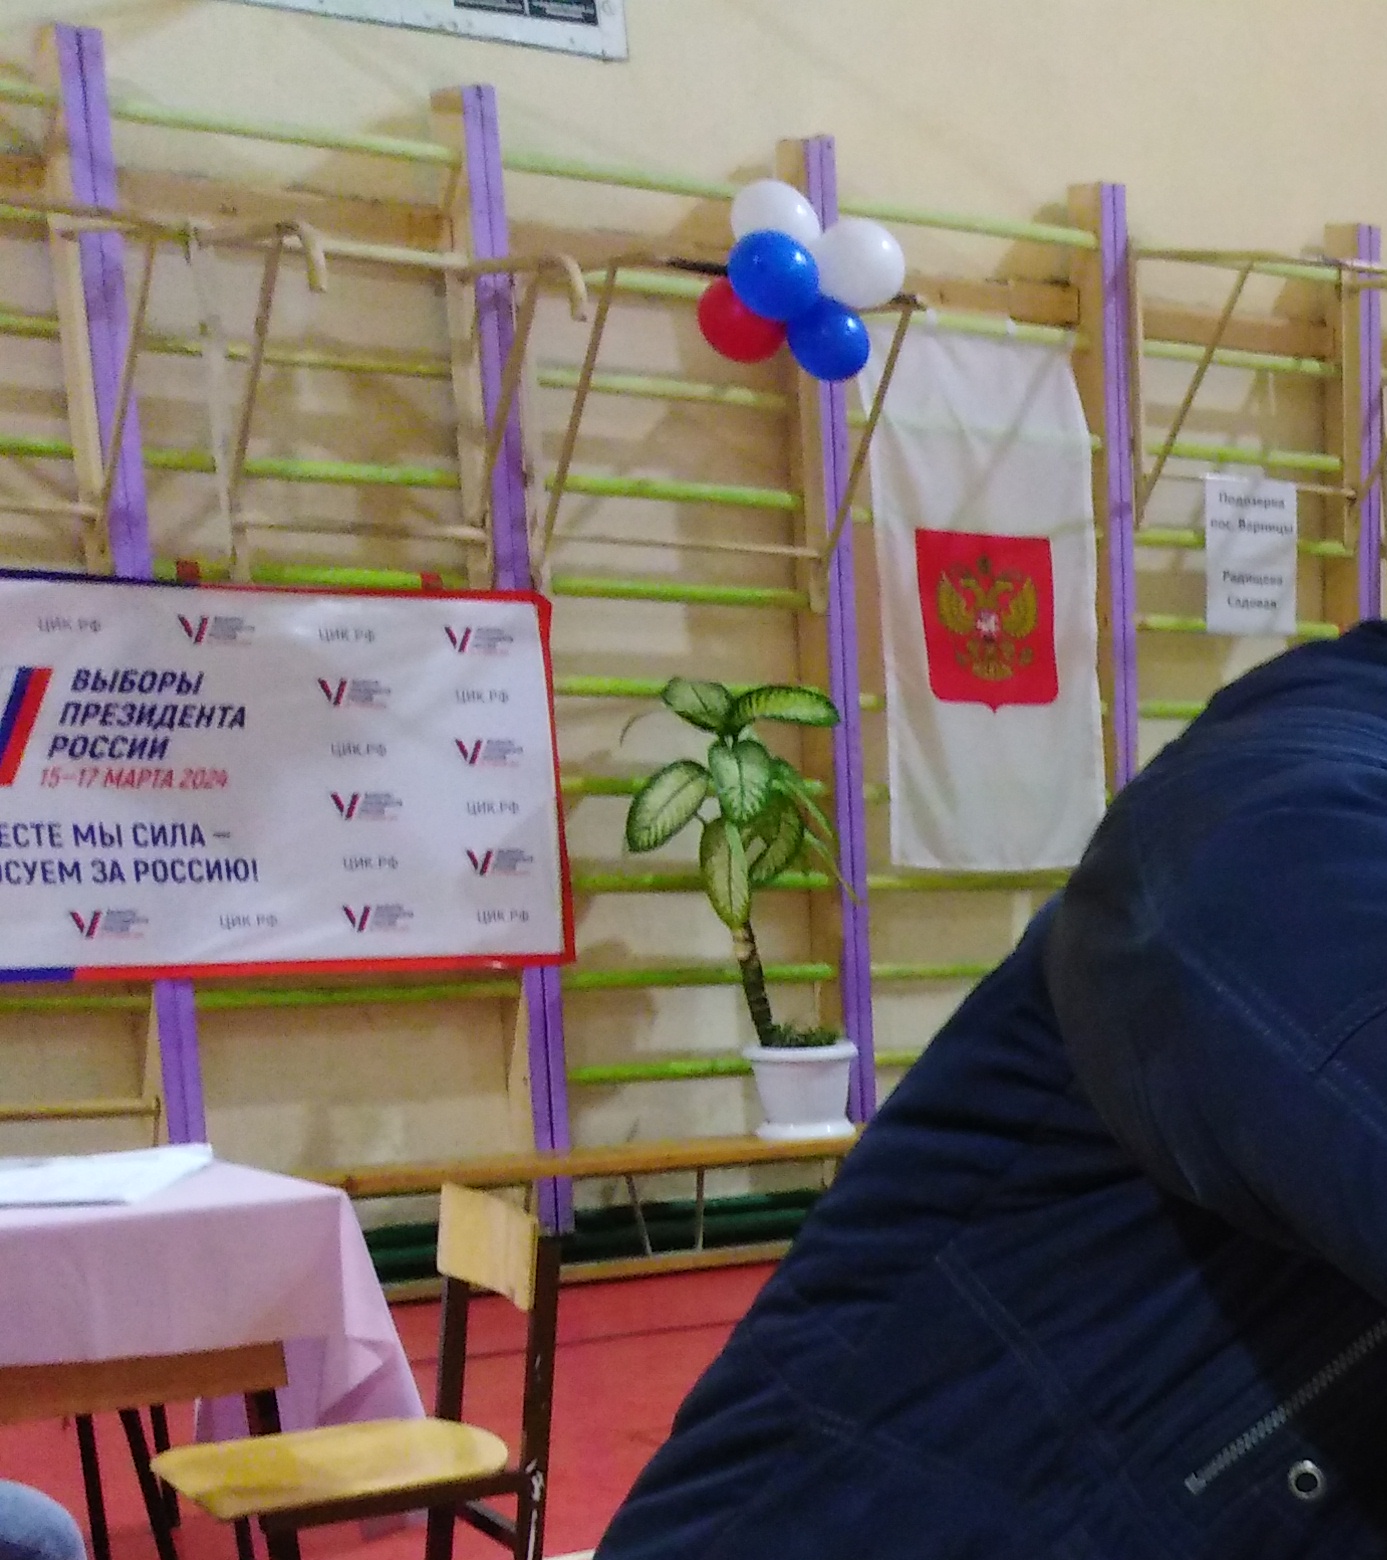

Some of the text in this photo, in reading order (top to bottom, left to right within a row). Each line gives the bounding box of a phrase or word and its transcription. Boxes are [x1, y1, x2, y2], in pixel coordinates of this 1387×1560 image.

[70, 668, 204, 695] ВЫБОРЫ
[58, 701, 247, 731] ПРЕЗИДЕНТА
[47, 734, 170, 761] РОССИИ
[103, 767, 175, 789] МАРТА
[178, 768, 229, 790] 2024
[72, 823, 123, 848] МЫ
[131, 823, 206, 848] СИЛА
[0, 859, 259, 885] СУЕМ ЗА РОССИЮ!
